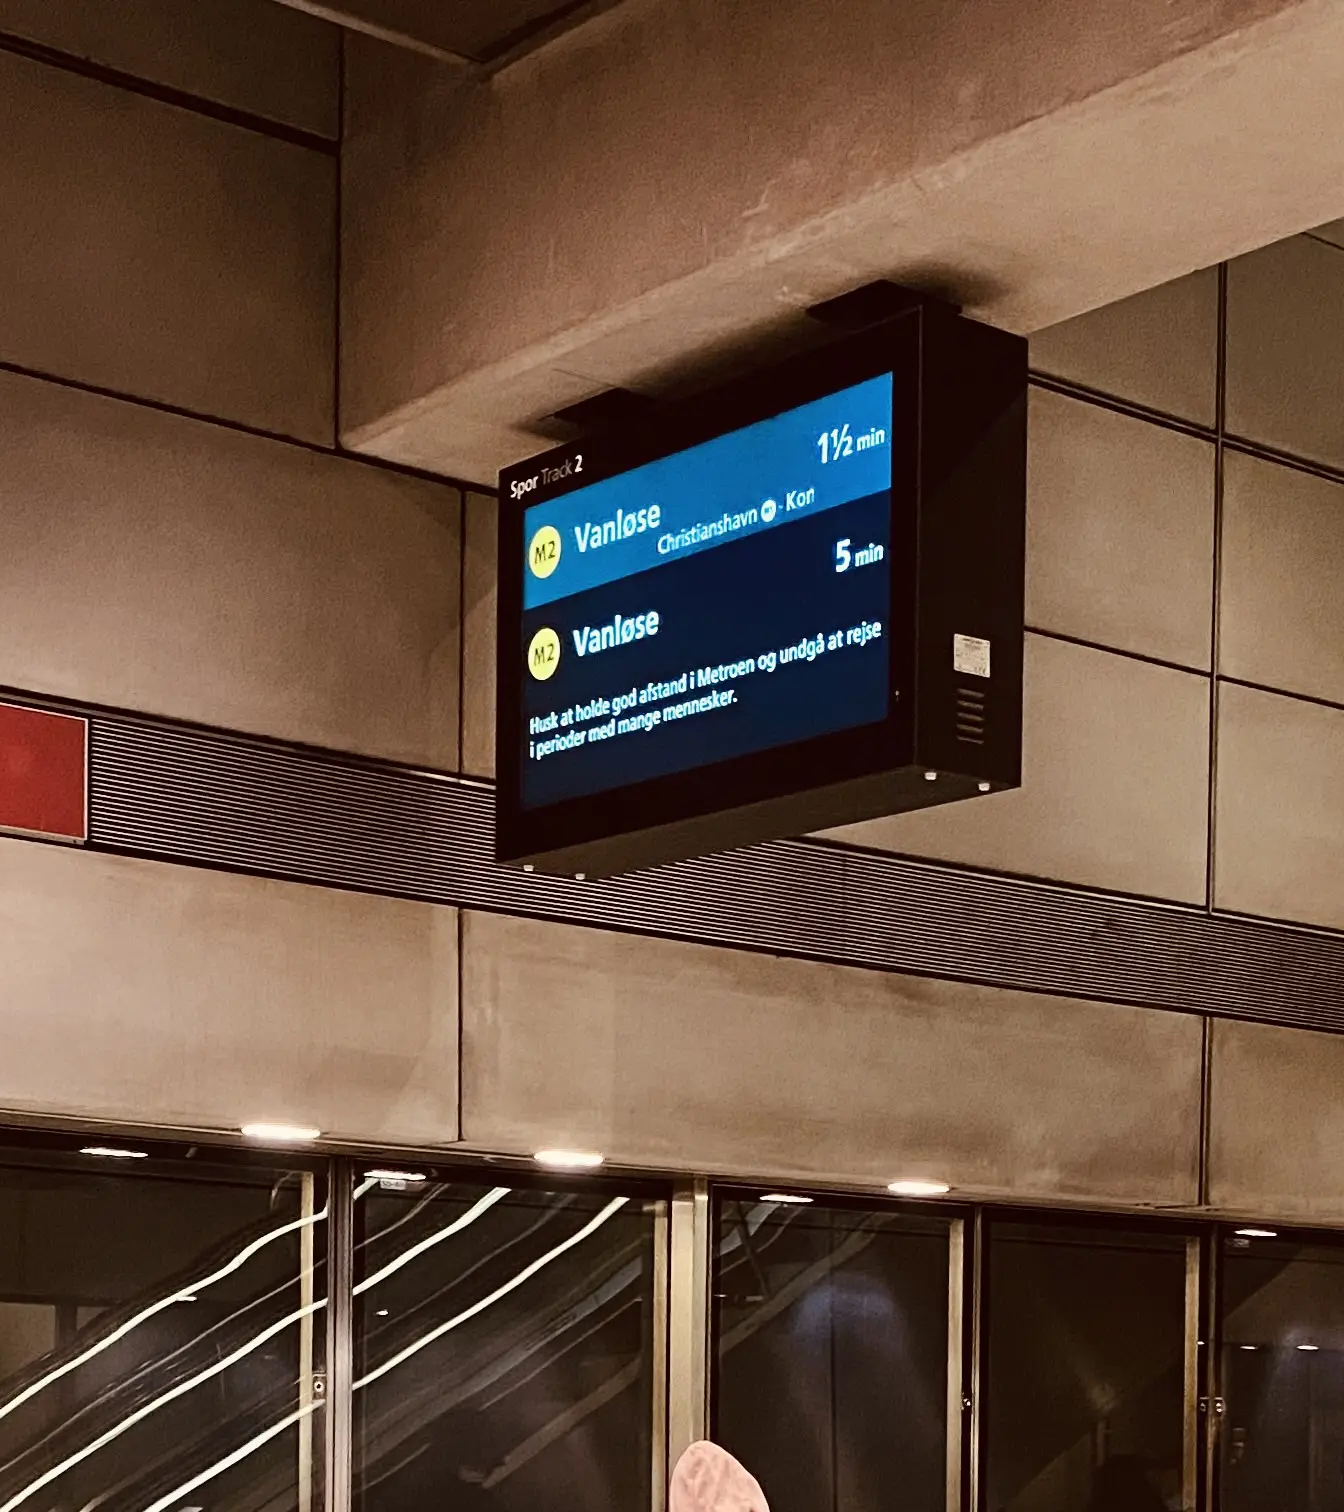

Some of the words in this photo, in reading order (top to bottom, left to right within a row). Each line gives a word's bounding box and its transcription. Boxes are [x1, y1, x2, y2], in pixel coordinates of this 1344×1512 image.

[856, 427, 885, 451] min
[510, 476, 539, 500] Spor
[541, 459, 573, 485] Track
[574, 455, 583, 473] 2
[534, 541, 556, 564] M2
[574, 504, 661, 553] Vanløse
[657, 508, 758, 555] Christianshavn
[786, 488, 815, 512] Kon
[835, 538, 851, 573] 5
[854, 543, 884, 567] min
[533, 643, 555, 666] M2
[573, 611, 660, 657] Vanløse
[529, 711, 559, 735] Husk
[559, 708, 574, 727] at
[575, 697, 610, 722] holde
[611, 687, 638, 716] god
[639, 672, 687, 704] afstand
[689, 671, 695, 690] i
[697, 658, 755, 687] Metroen
[757, 652, 777, 672] og
[779, 633, 825, 662] undgå
[827, 630, 844, 651] at
[846, 621, 882, 647] rejse
[529, 741, 535, 759] i
[536, 730, 587, 761] perioder
[588, 718, 616, 743] med
[617, 710, 661, 732] mange
[662, 689, 738, 723] mennesker.
